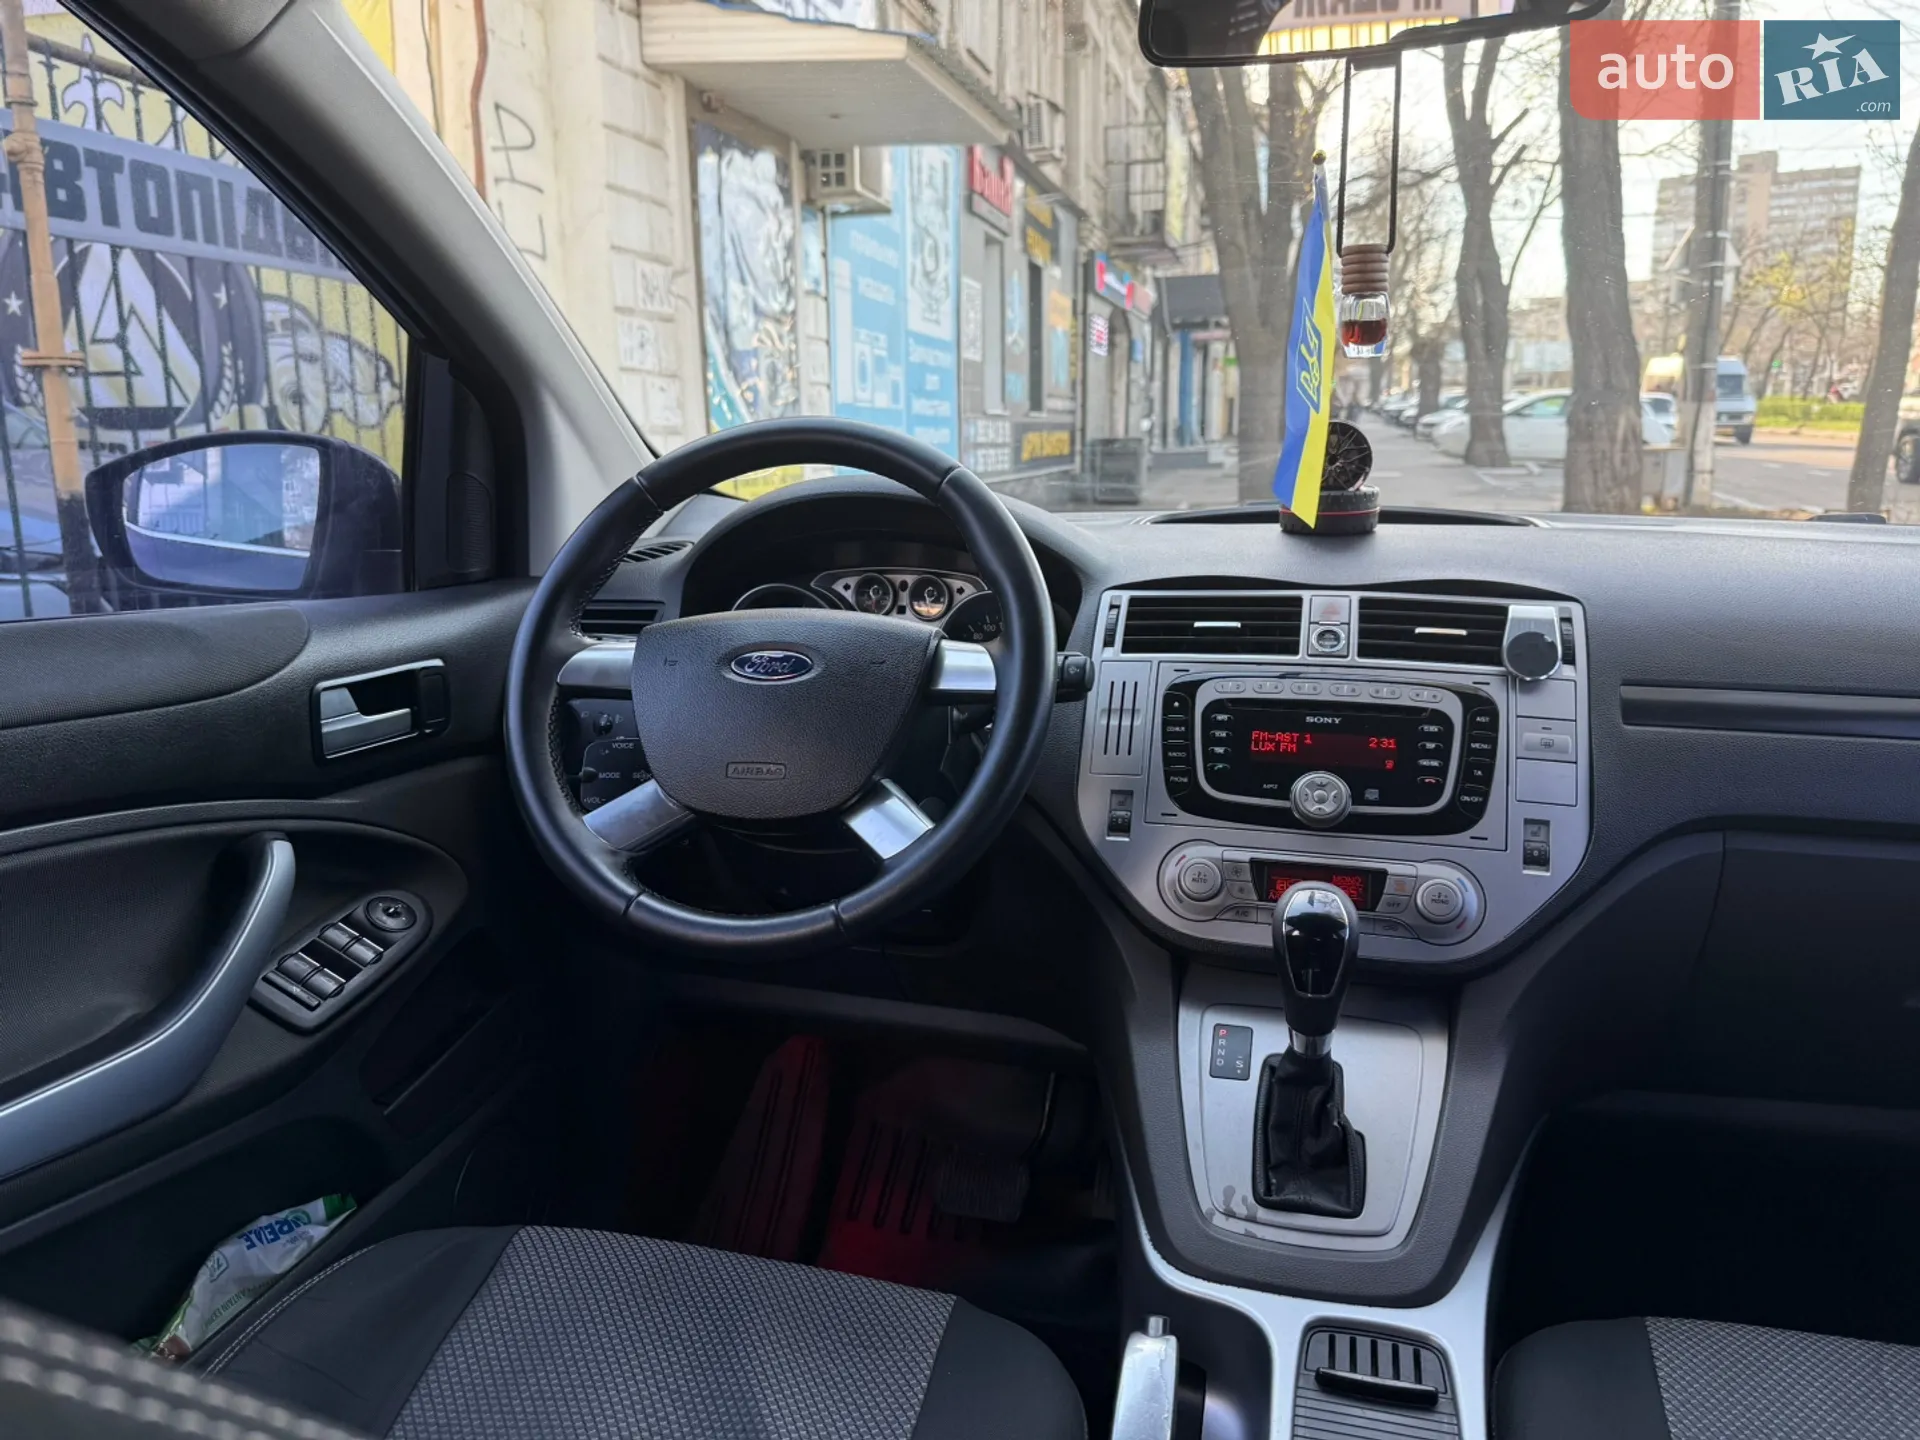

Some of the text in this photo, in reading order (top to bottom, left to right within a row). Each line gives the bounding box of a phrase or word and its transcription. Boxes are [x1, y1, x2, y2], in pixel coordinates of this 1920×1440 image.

[743, 653, 797, 674] Ford
[1305, 716, 1342, 724] SONY
[1251, 731, 1313, 745] FM-AST 1
[1251, 741, 1297, 753] LUX FM
[731, 766, 784, 777] AIRBAG
[1218, 1029, 1227, 1038] P
[1218, 1038, 1226, 1046] R
[1217, 1048, 1226, 1056] N
[1216, 1058, 1224, 1067] D
